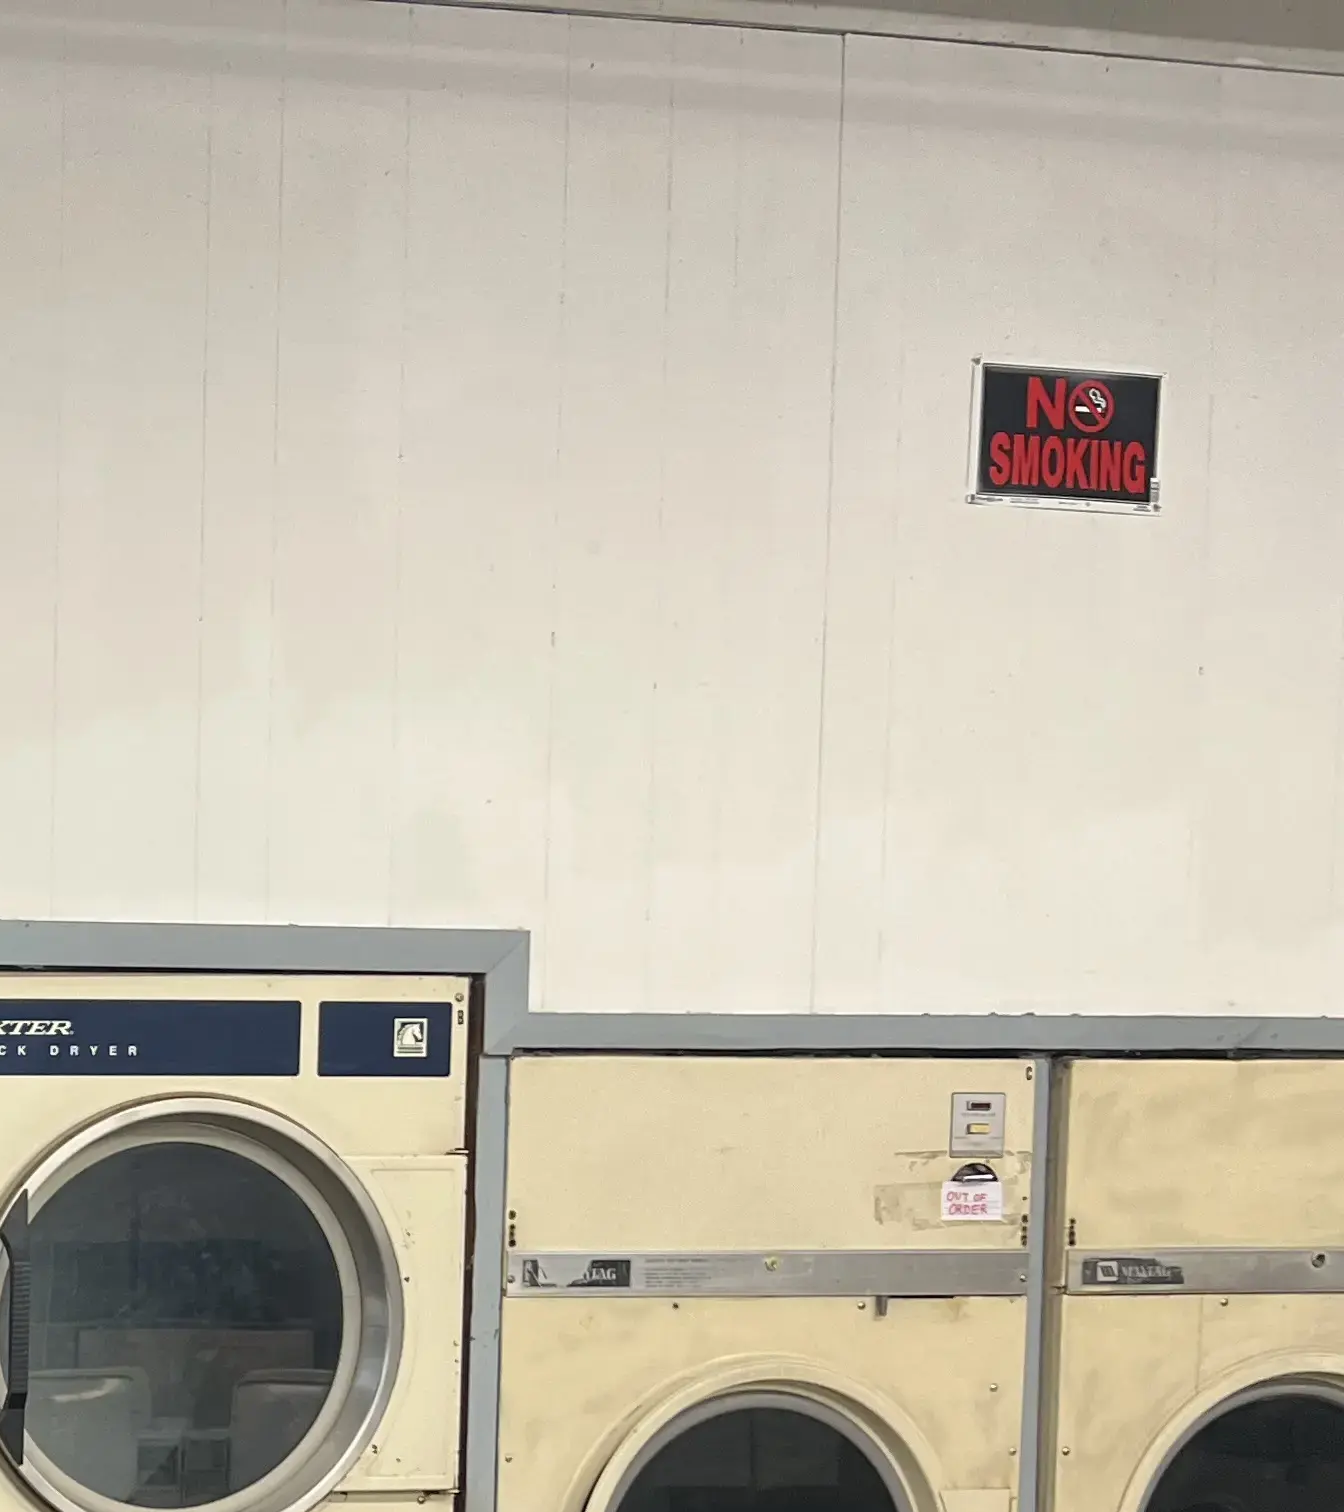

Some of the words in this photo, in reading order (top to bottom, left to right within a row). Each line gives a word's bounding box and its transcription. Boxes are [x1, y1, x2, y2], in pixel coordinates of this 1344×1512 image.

[989, 432, 1146, 494] SMOKING
[49, 1045, 139, 1057] DRYER
[946, 1191, 969, 1202] OUT
[949, 1203, 988, 1215] ORDER
